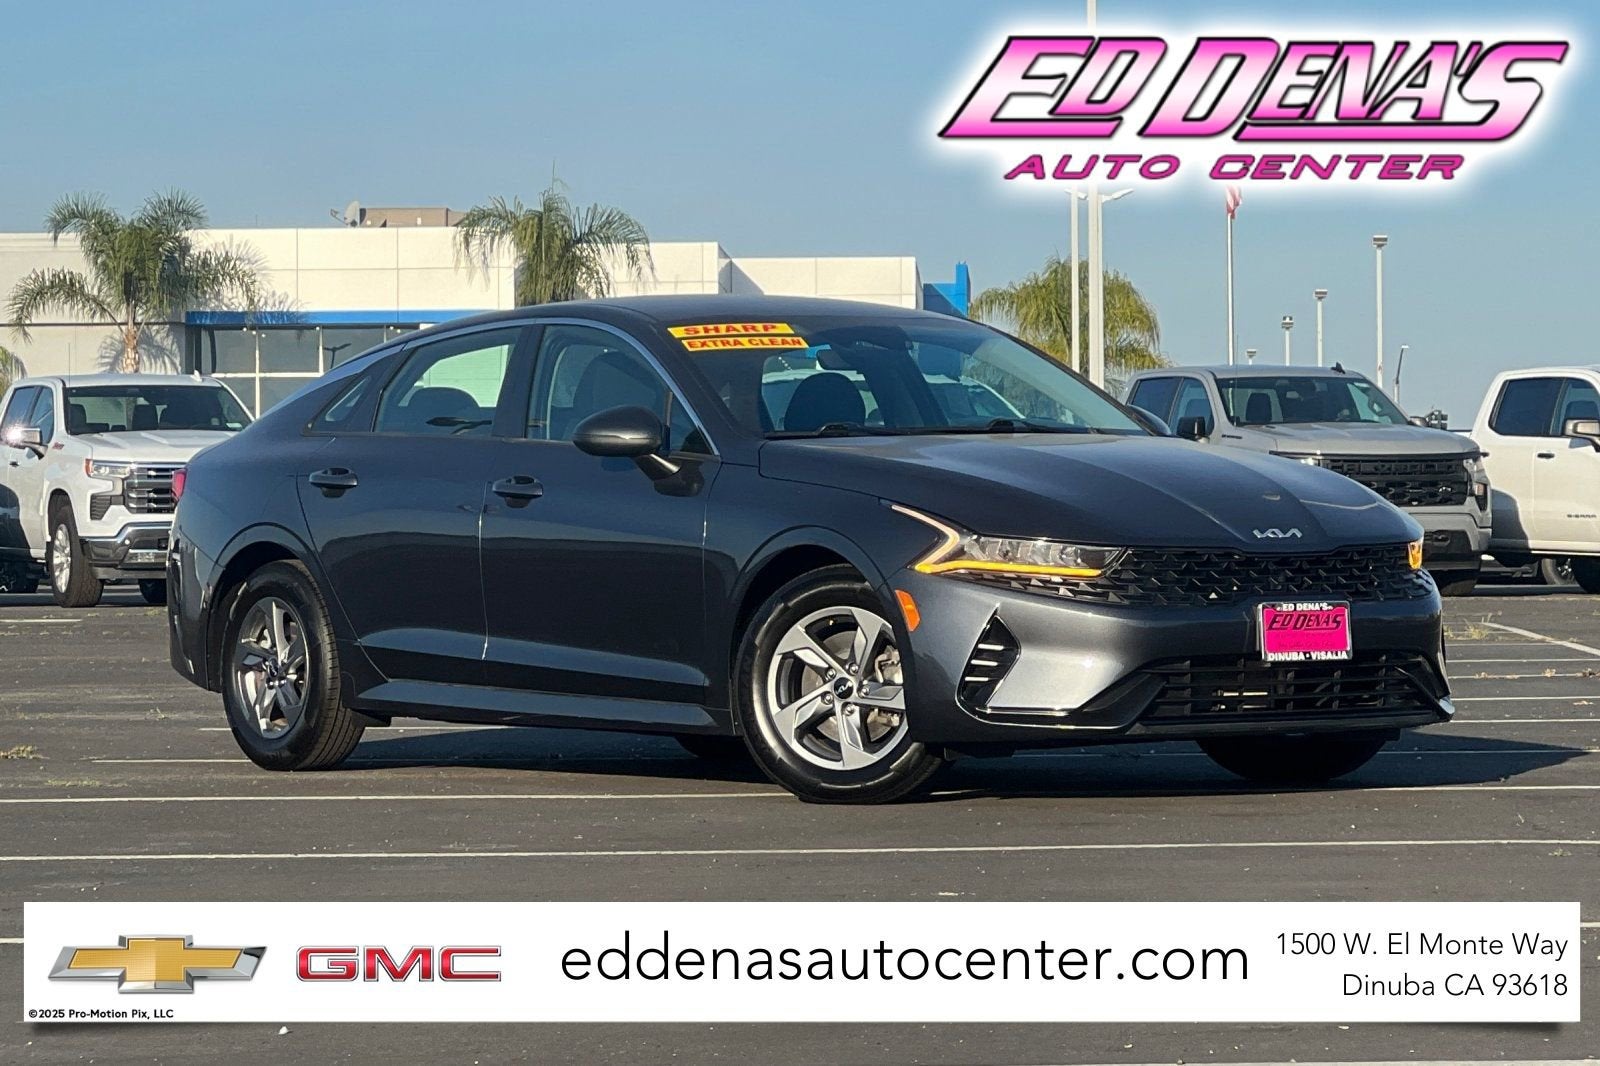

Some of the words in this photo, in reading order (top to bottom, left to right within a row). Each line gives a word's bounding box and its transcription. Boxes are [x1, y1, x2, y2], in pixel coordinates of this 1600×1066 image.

[683, 324, 778, 336] SHARP
[687, 338, 745, 349] EXTRA
[748, 337, 801, 347] CLEAN
[1282, 603, 1295, 612] ED
[1266, 613, 1293, 631] ED
[1267, 652, 1306, 662] DINUBA
[1311, 651, 1348, 660] VISALIA
